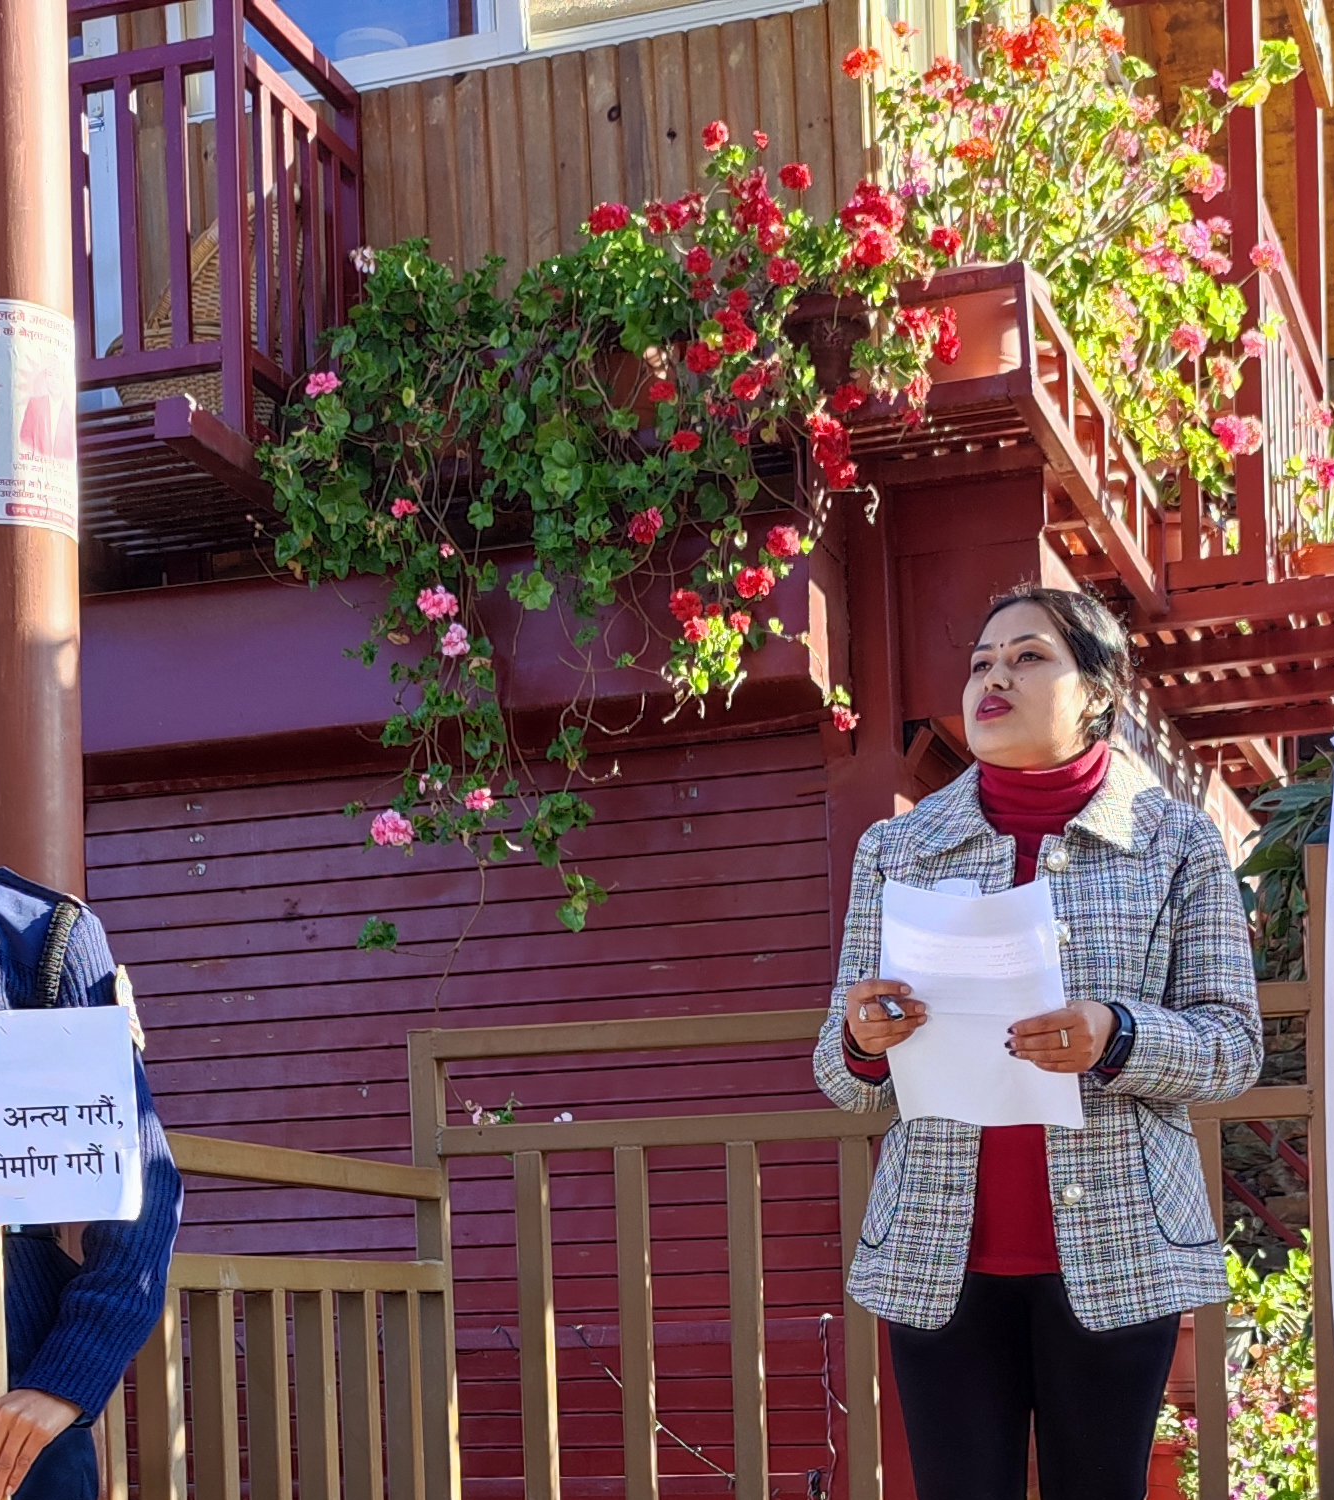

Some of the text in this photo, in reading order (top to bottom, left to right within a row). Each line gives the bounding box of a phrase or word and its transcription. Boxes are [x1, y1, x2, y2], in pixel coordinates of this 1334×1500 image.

[3, 1105, 70, 1130] अन्त्य
[73, 1094, 124, 1130] गरौं,
[63, 1142, 106, 1176] गरौं
